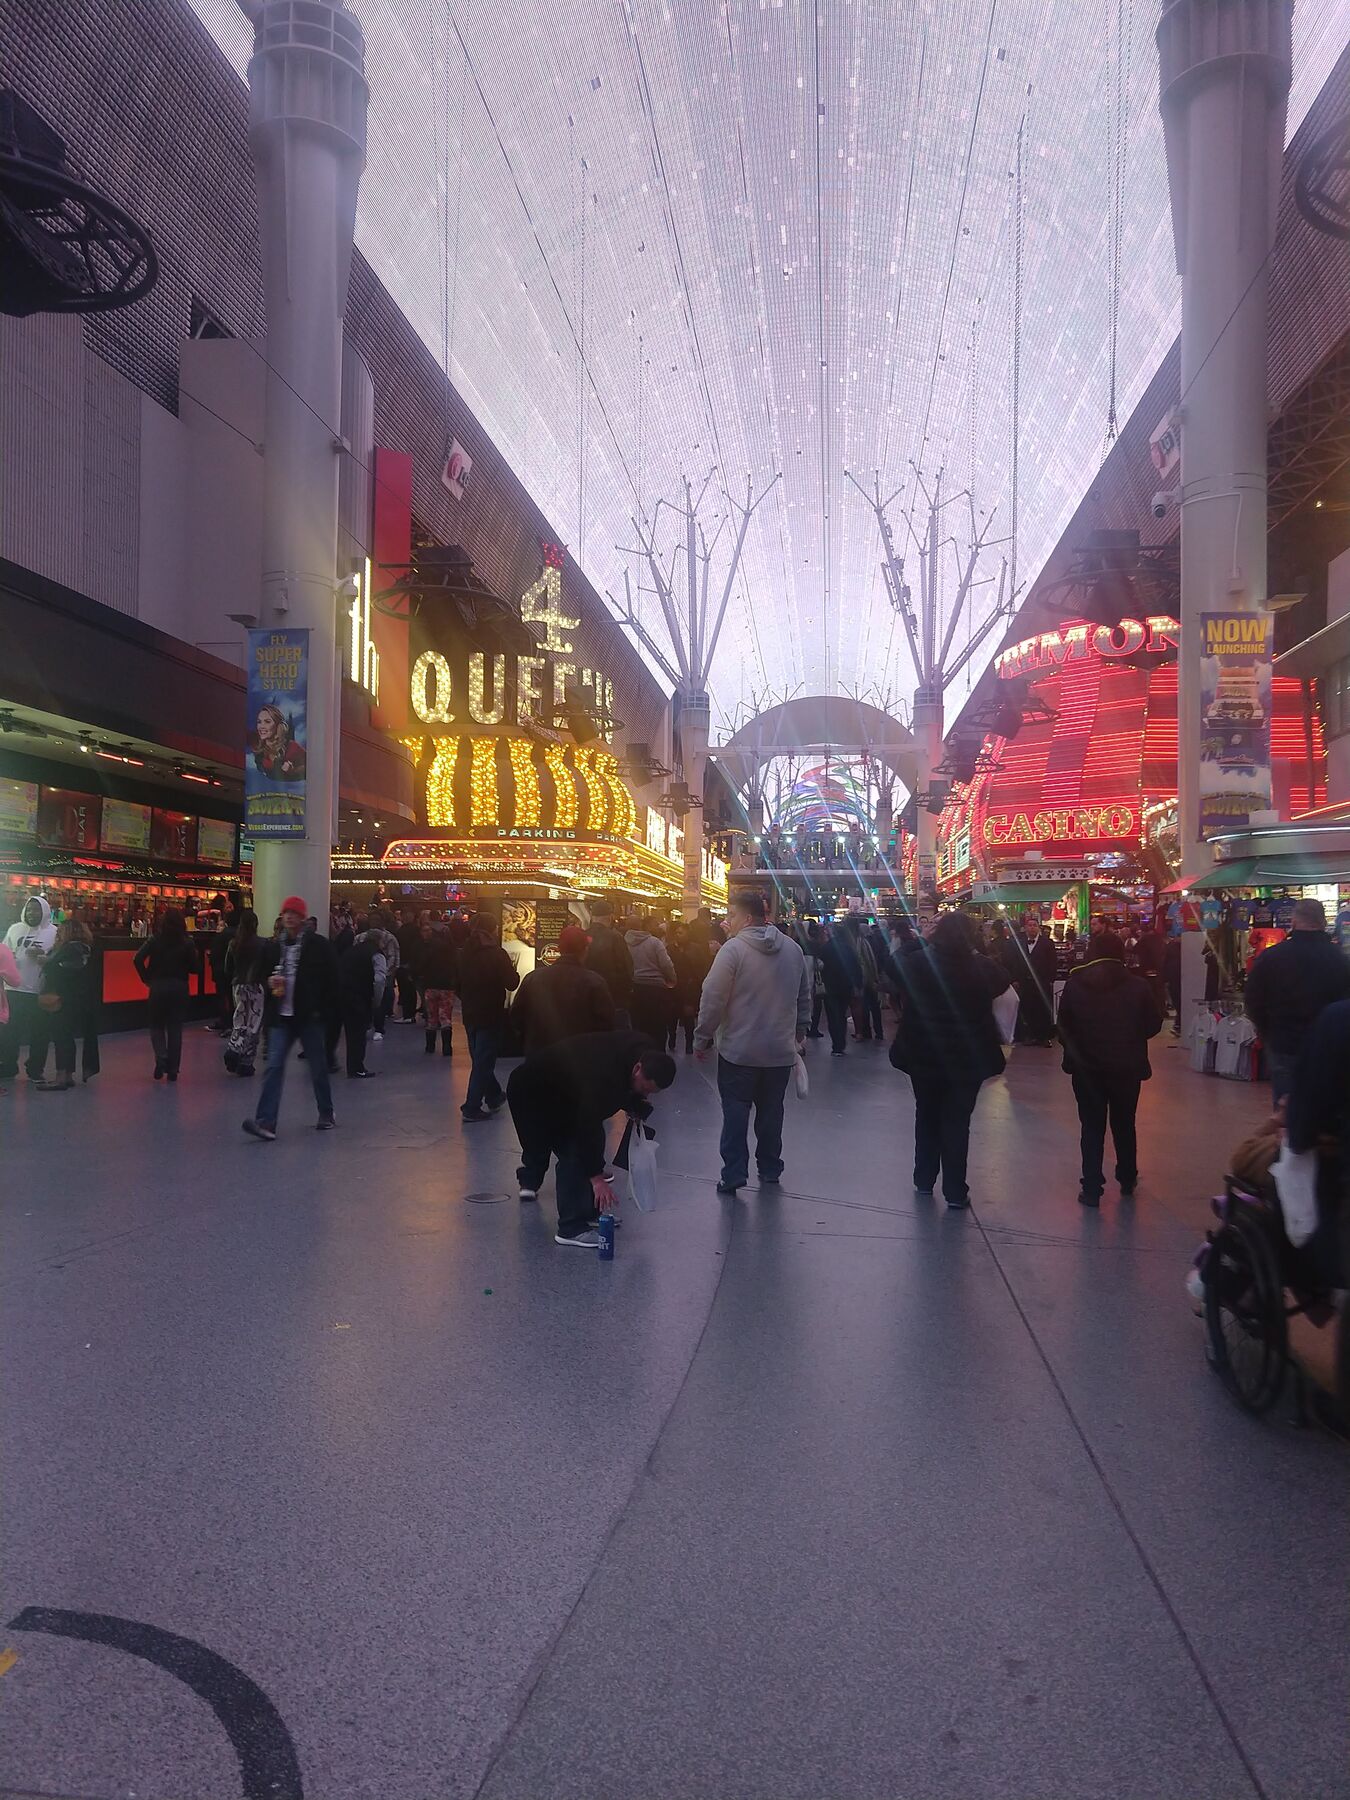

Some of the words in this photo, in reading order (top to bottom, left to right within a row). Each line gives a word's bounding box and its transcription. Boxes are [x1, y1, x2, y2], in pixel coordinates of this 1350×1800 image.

[519, 566, 582, 654] 4
[1206, 618, 1268, 642] NOW
[271, 634, 288, 646] FLY
[255, 647, 303, 662] SUPER
[1206, 643, 1266, 654] LAUNCHING
[259, 664, 299, 678] HERO
[263, 679, 296, 690] STYLE
[983, 805, 1134, 844] CASINO
[497, 829, 576, 839] PARKING
